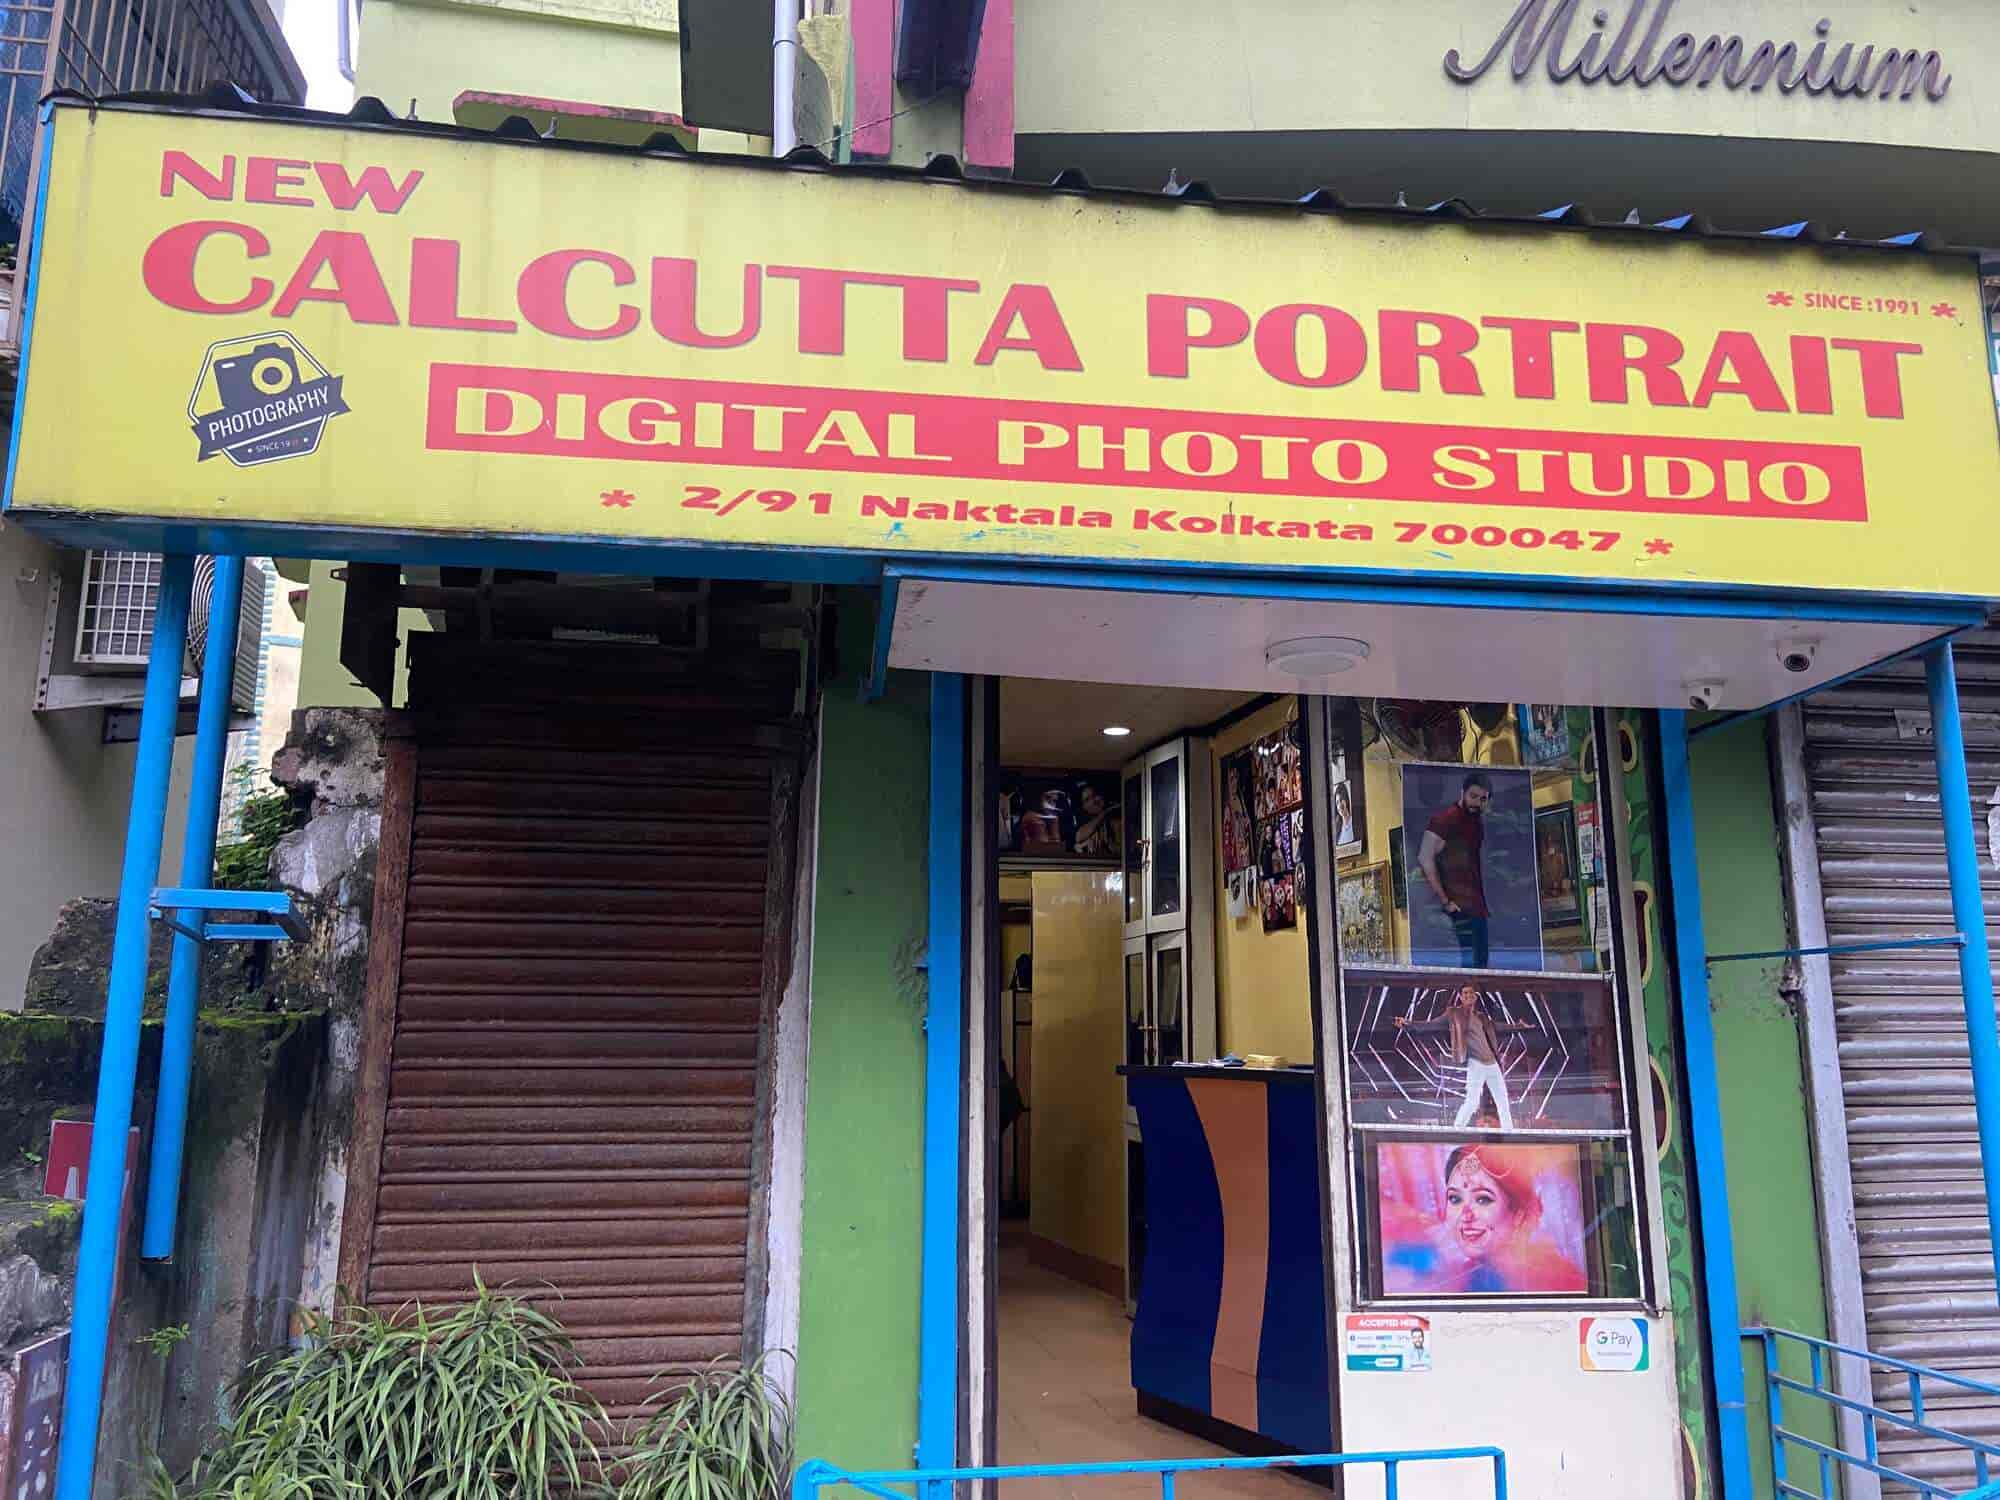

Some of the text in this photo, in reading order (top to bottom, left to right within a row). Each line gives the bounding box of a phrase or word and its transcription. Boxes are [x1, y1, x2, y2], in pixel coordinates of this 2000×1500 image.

[1443, 0, 1951, 102] Millennium
[160, 149, 424, 214] NEW
[142, 220, 1924, 420] CALCUTTA PORTRAIT
[208, 385, 329, 441] PHOTOGRAPHY
[455, 387, 1831, 505] DIGITAL PHOTO STUDIO
[682, 485, 1621, 552] 2/91 Naktala Kolkata 700047
[1611, 1331, 1632, 1349] Pay
